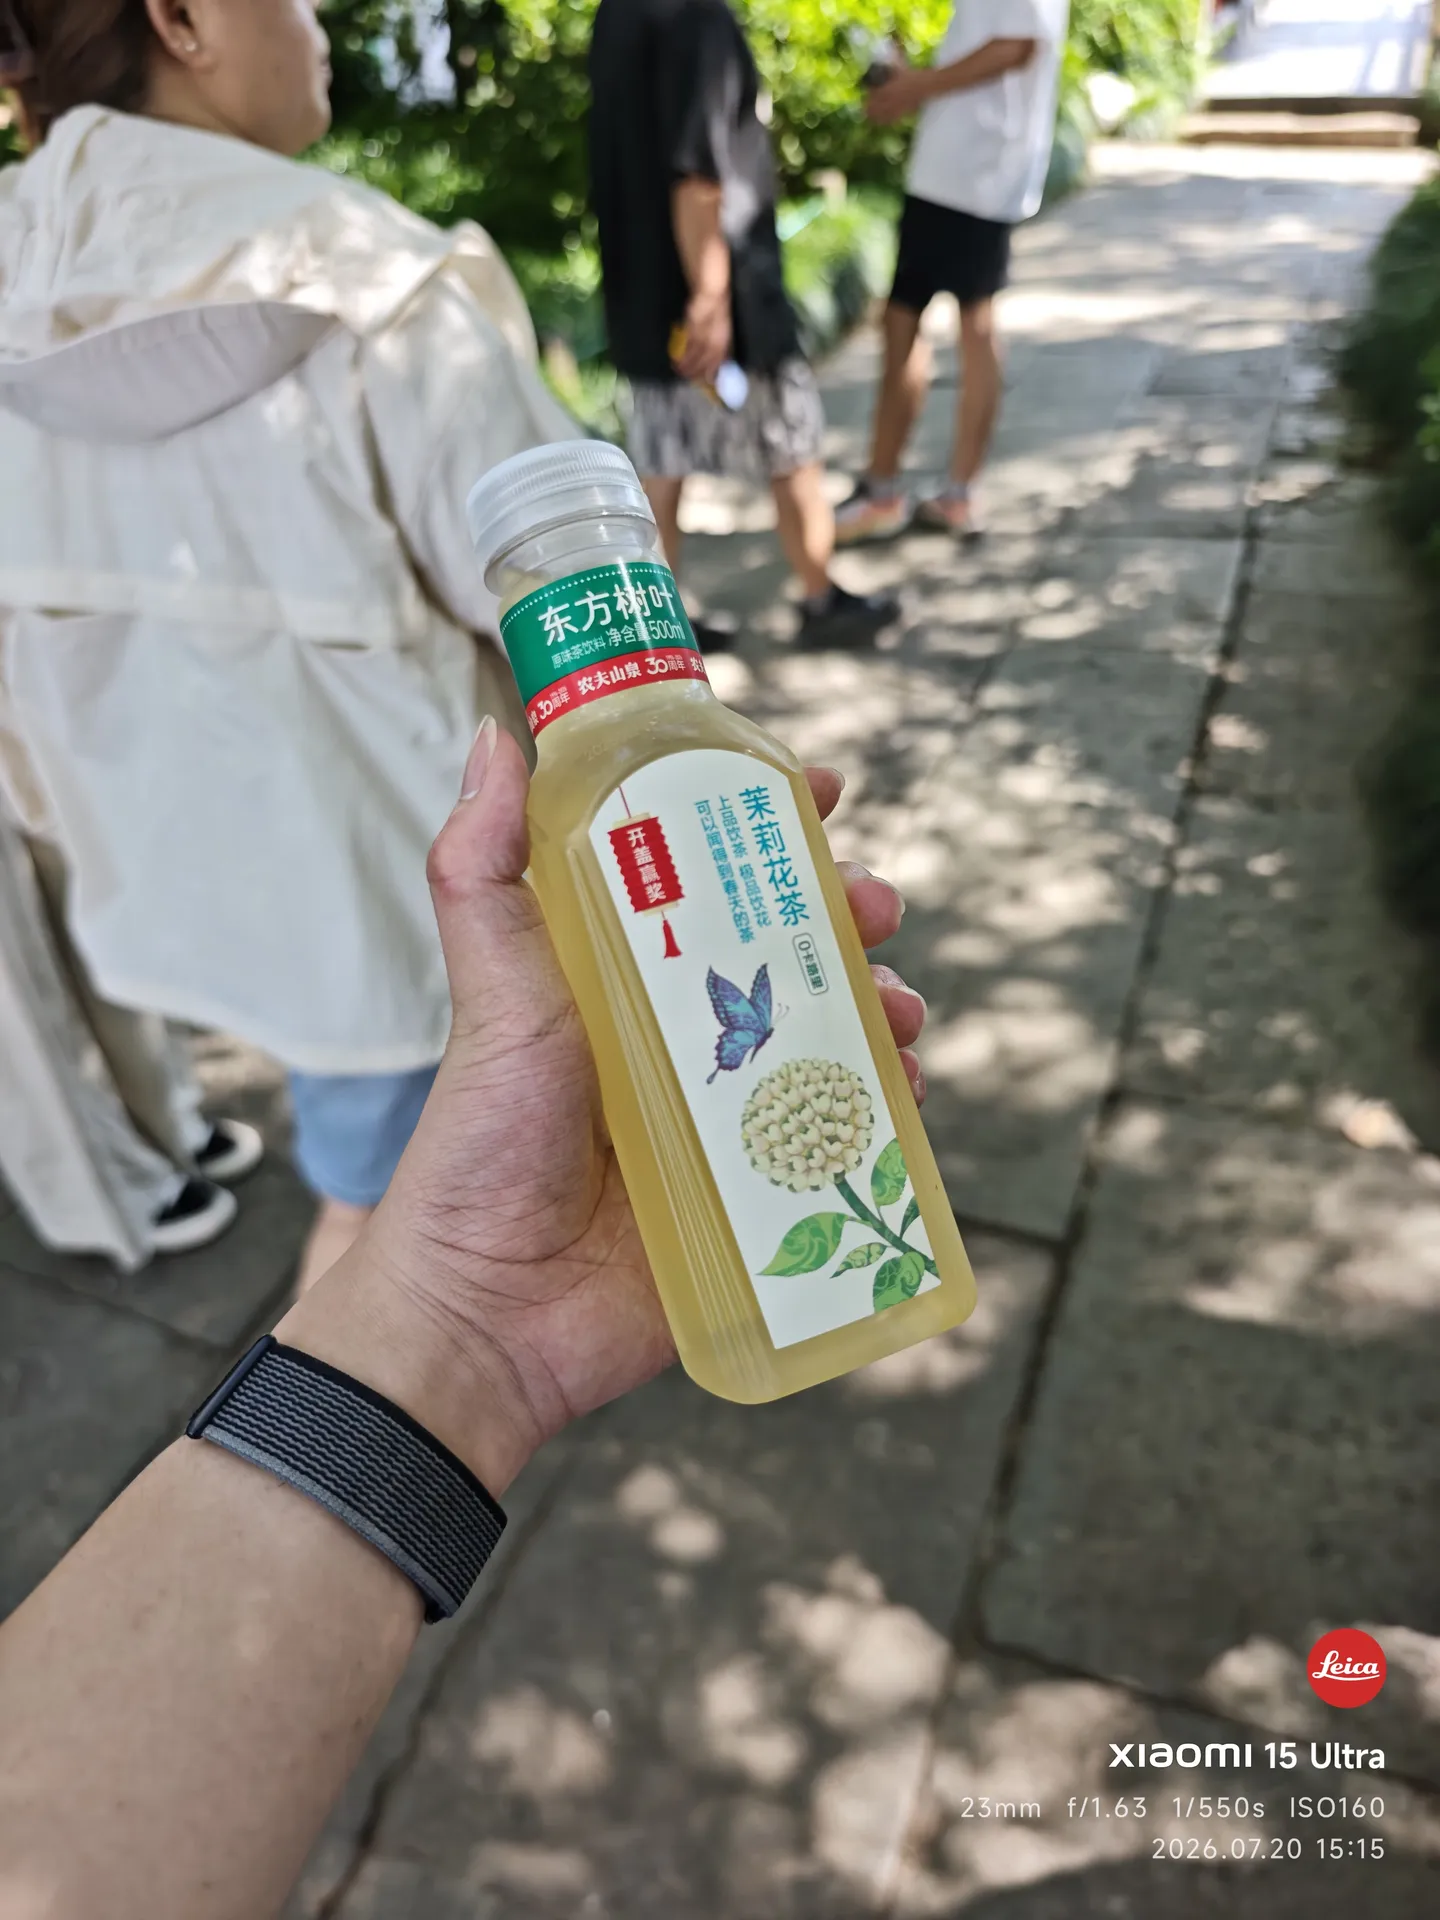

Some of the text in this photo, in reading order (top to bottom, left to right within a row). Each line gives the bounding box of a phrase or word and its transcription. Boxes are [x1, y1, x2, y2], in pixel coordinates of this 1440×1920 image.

[538, 581, 676, 646] 东方树叶
[551, 636, 606, 670] 原味茶饮料
[577, 662, 642, 695] 农夫山泉
[717, 795, 748, 859] 上品饮茶
[739, 785, 810, 928] 茉莉花茶
[627, 826, 667, 903] 开盖赢奖
[694, 799, 756, 945] 可以闻得到春天的茶
